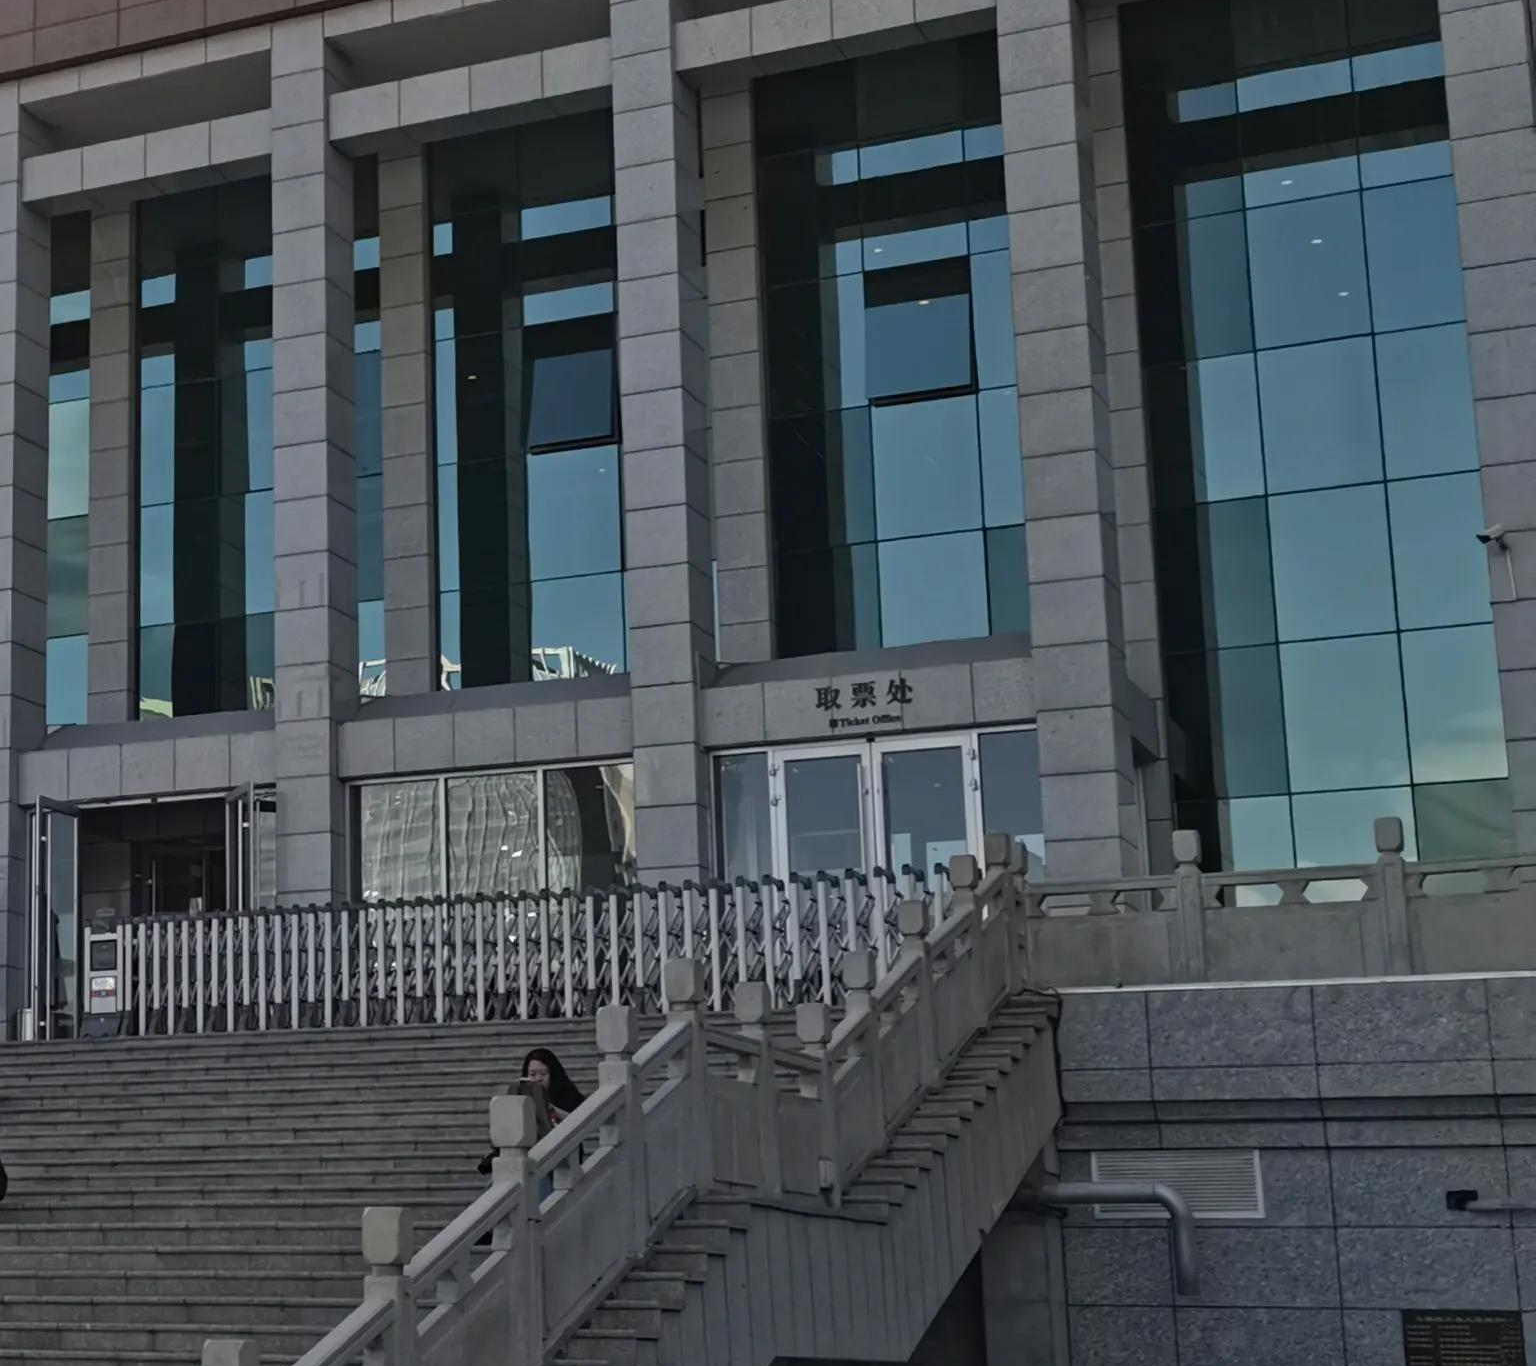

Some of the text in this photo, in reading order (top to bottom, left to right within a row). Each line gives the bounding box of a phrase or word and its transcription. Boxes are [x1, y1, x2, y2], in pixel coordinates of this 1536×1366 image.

[815, 677, 914, 711] 取票处
[839, 717, 870, 727] Ticket
[872, 714, 901, 724] Office
